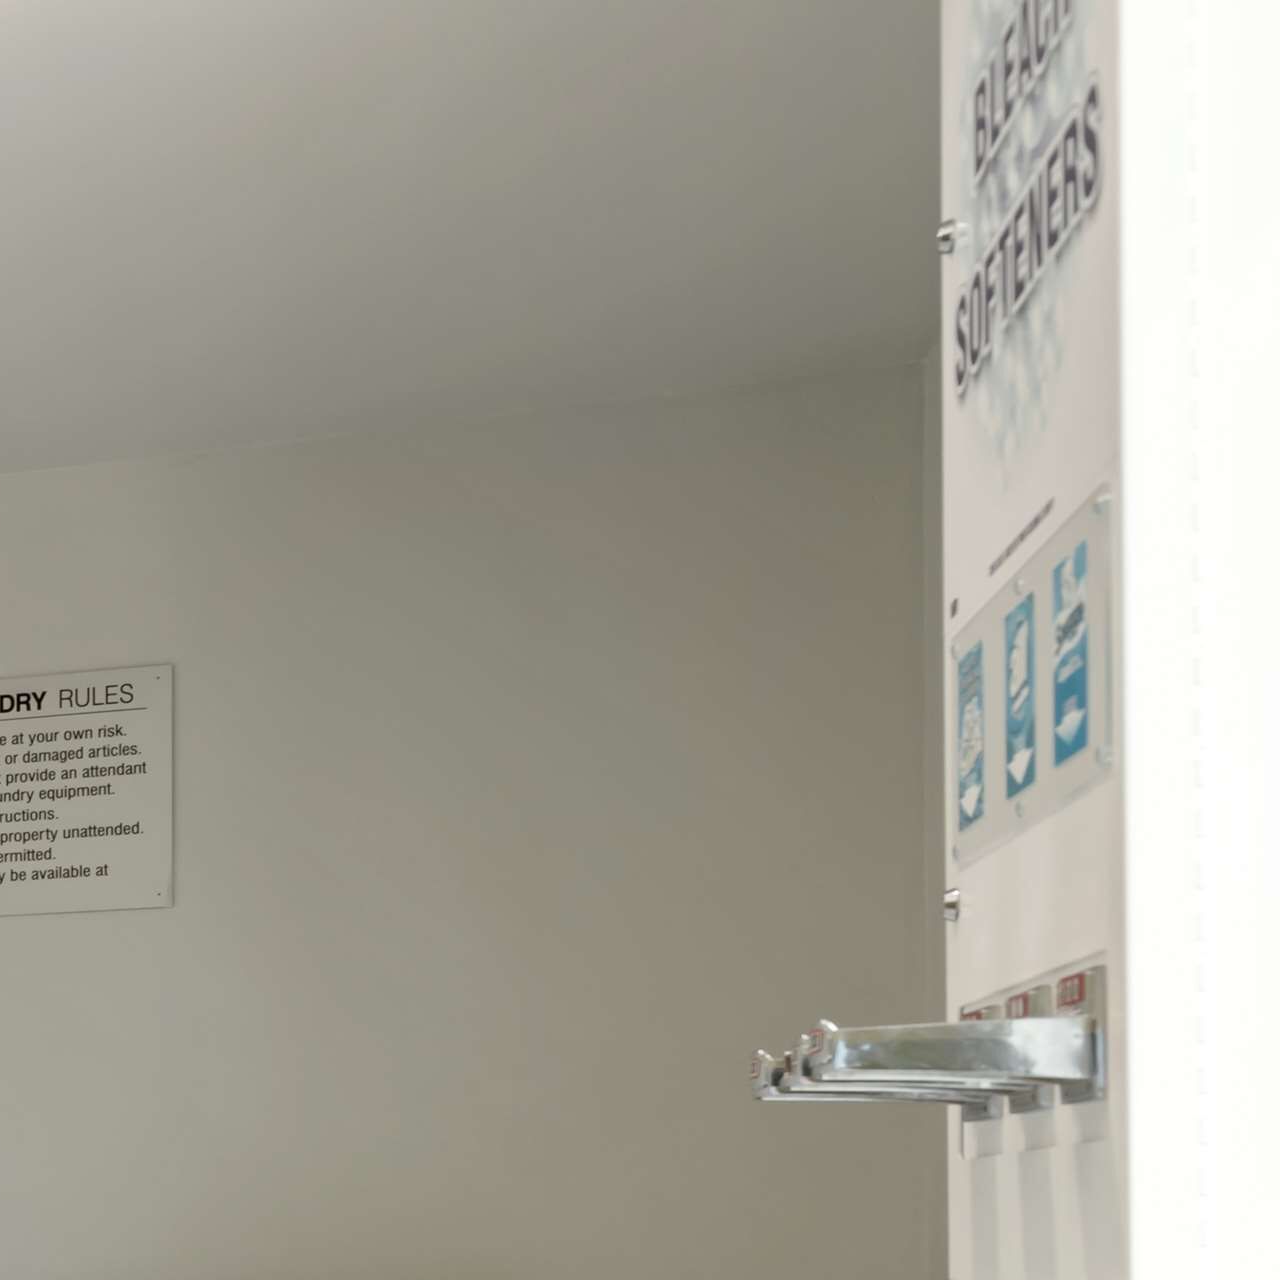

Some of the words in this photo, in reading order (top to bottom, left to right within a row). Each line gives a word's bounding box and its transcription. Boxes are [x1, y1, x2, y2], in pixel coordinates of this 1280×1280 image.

[974, 0, 1070, 177] BLEAC
[955, 82, 1099, 388] SOFTENERS
[58, 682, 135, 709] RULES
[10, 732, 25, 746] at
[27, 731, 60, 747] your
[63, 728, 94, 741] own
[97, 723, 127, 739] risk.
[4, 753, 19, 766] or
[21, 746, 84, 764] damaged
[87, 743, 142, 759] articles.
[5, 768, 57, 787] provide
[60, 768, 78, 781] an
[81, 761, 148, 779] attendant
[38, 782, 116, 802] equipment.
[0, 827, 59, 846] property
[62, 820, 144, 840] unattended.
[9, 868, 27, 882] be
[30, 864, 91, 881] available
[95, 863, 109, 877] at
